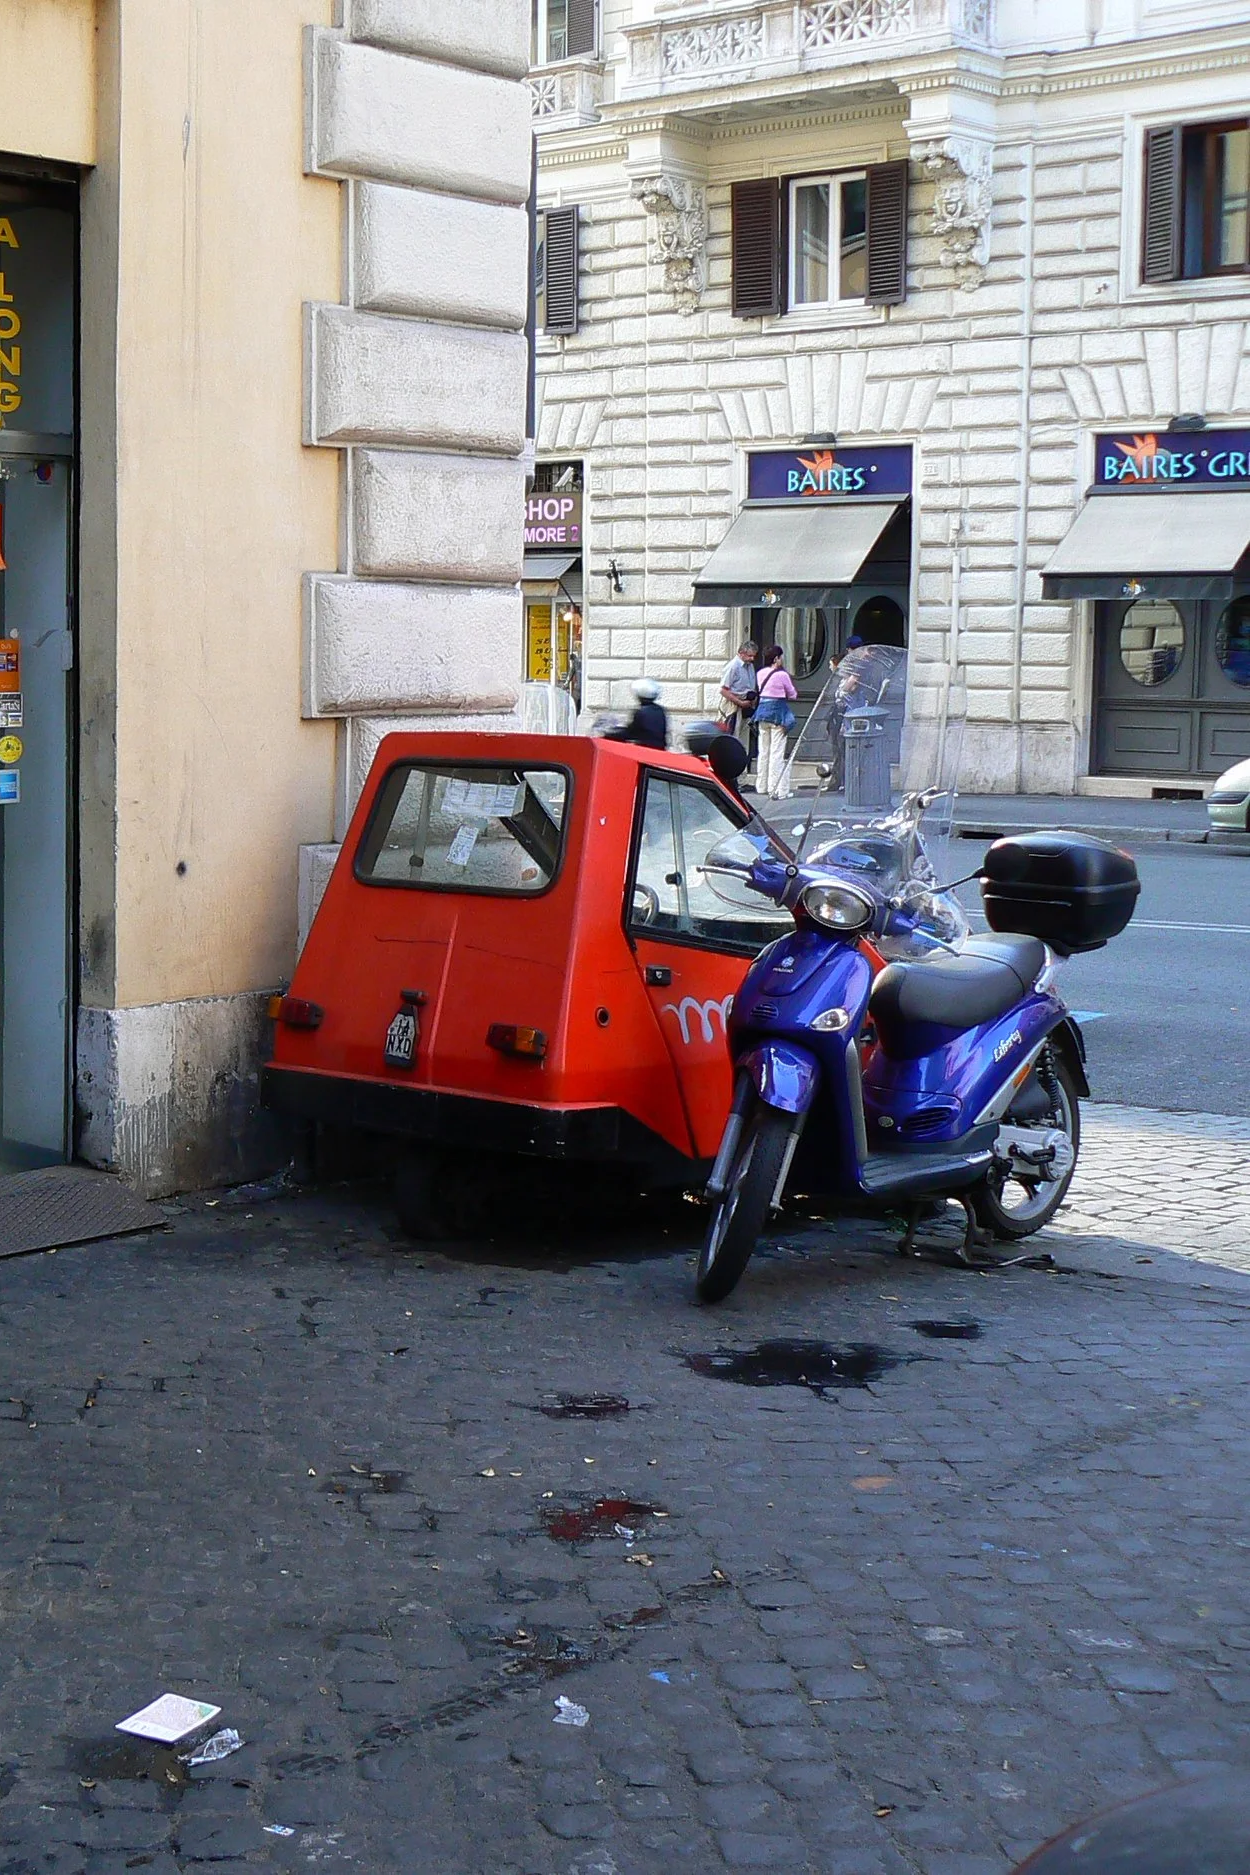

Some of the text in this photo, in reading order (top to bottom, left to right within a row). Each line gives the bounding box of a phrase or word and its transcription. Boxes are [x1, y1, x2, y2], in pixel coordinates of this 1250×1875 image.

[1104, 451, 1250, 480] BAIRES GR
[787, 467, 866, 492] BAIRES
[524, 525, 579, 543] MORE 2
